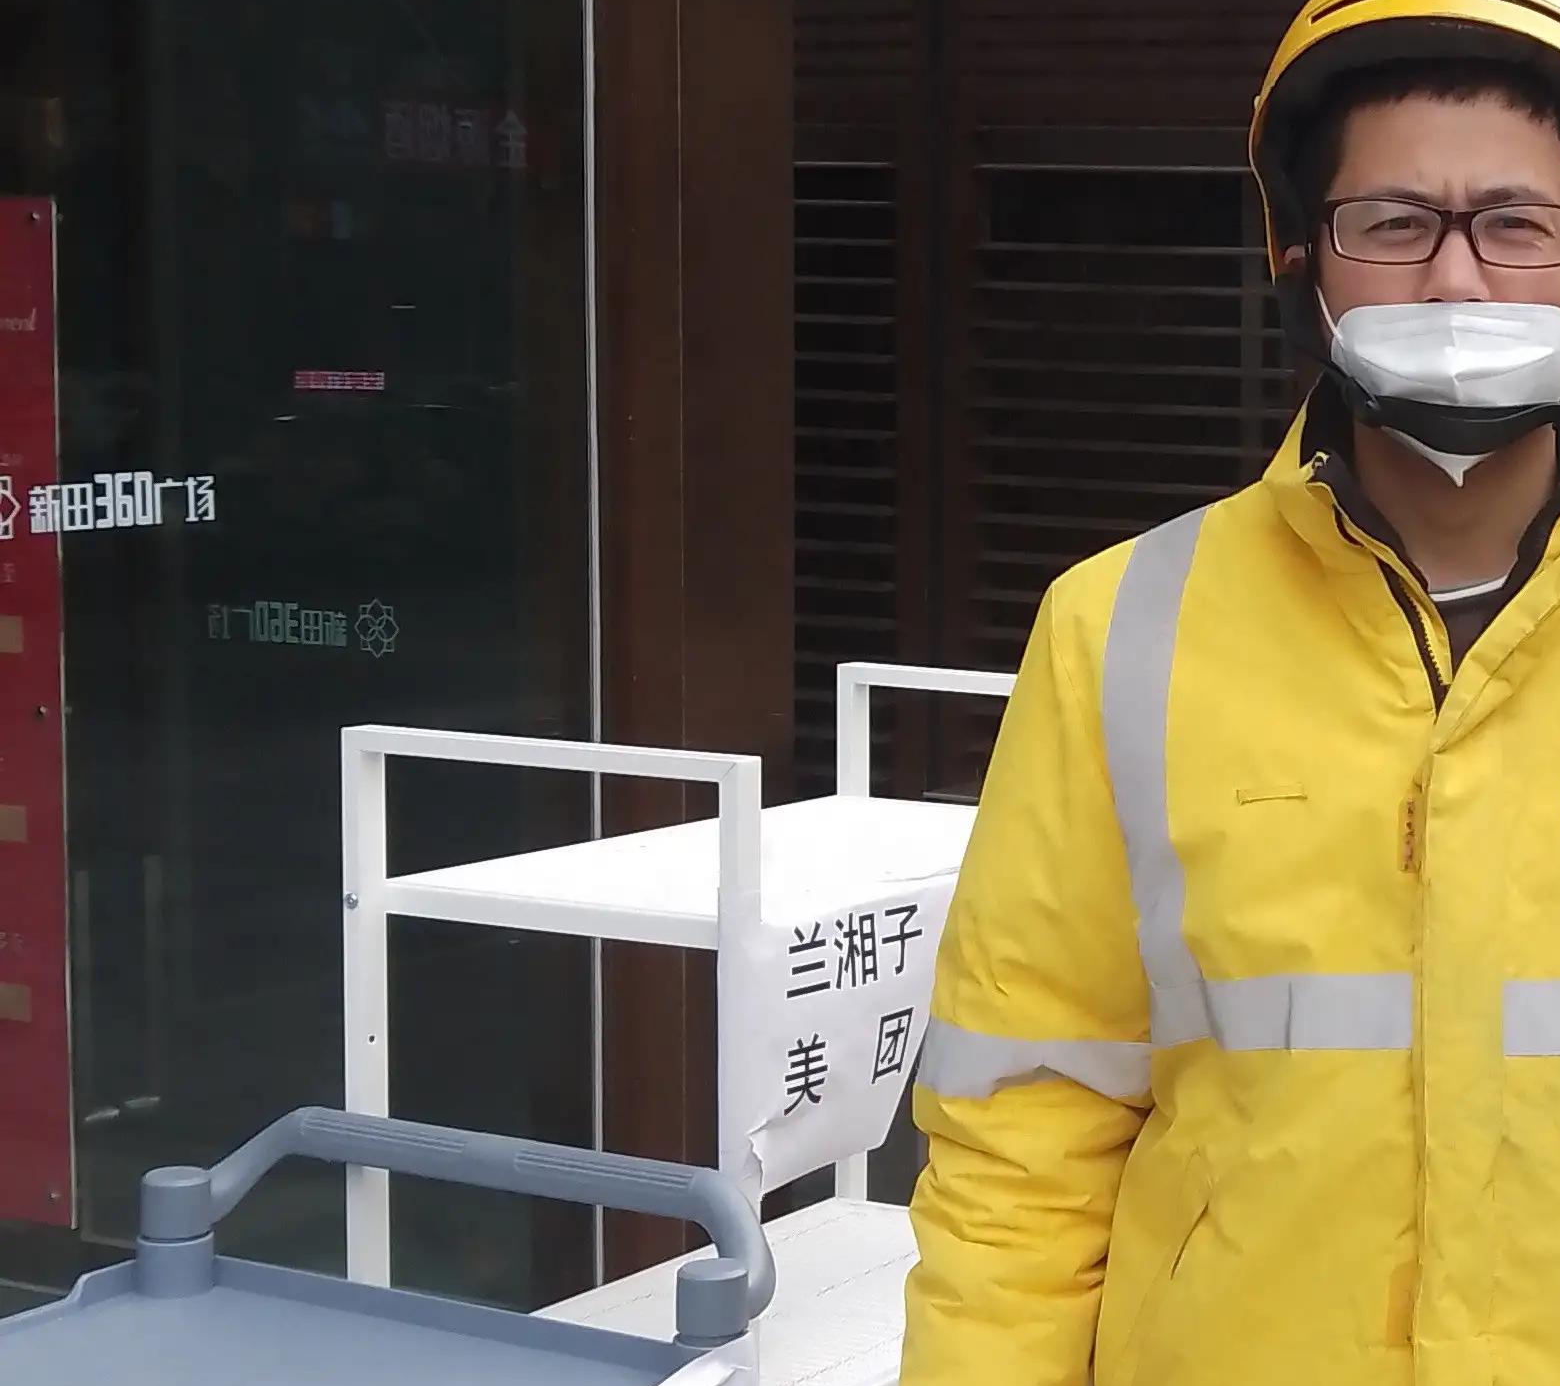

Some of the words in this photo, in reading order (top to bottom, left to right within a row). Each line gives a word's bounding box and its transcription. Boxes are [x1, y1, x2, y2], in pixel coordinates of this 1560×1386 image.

[29, 471, 216, 534] 新田360广场
[786, 903, 923, 999] 兰湘子
